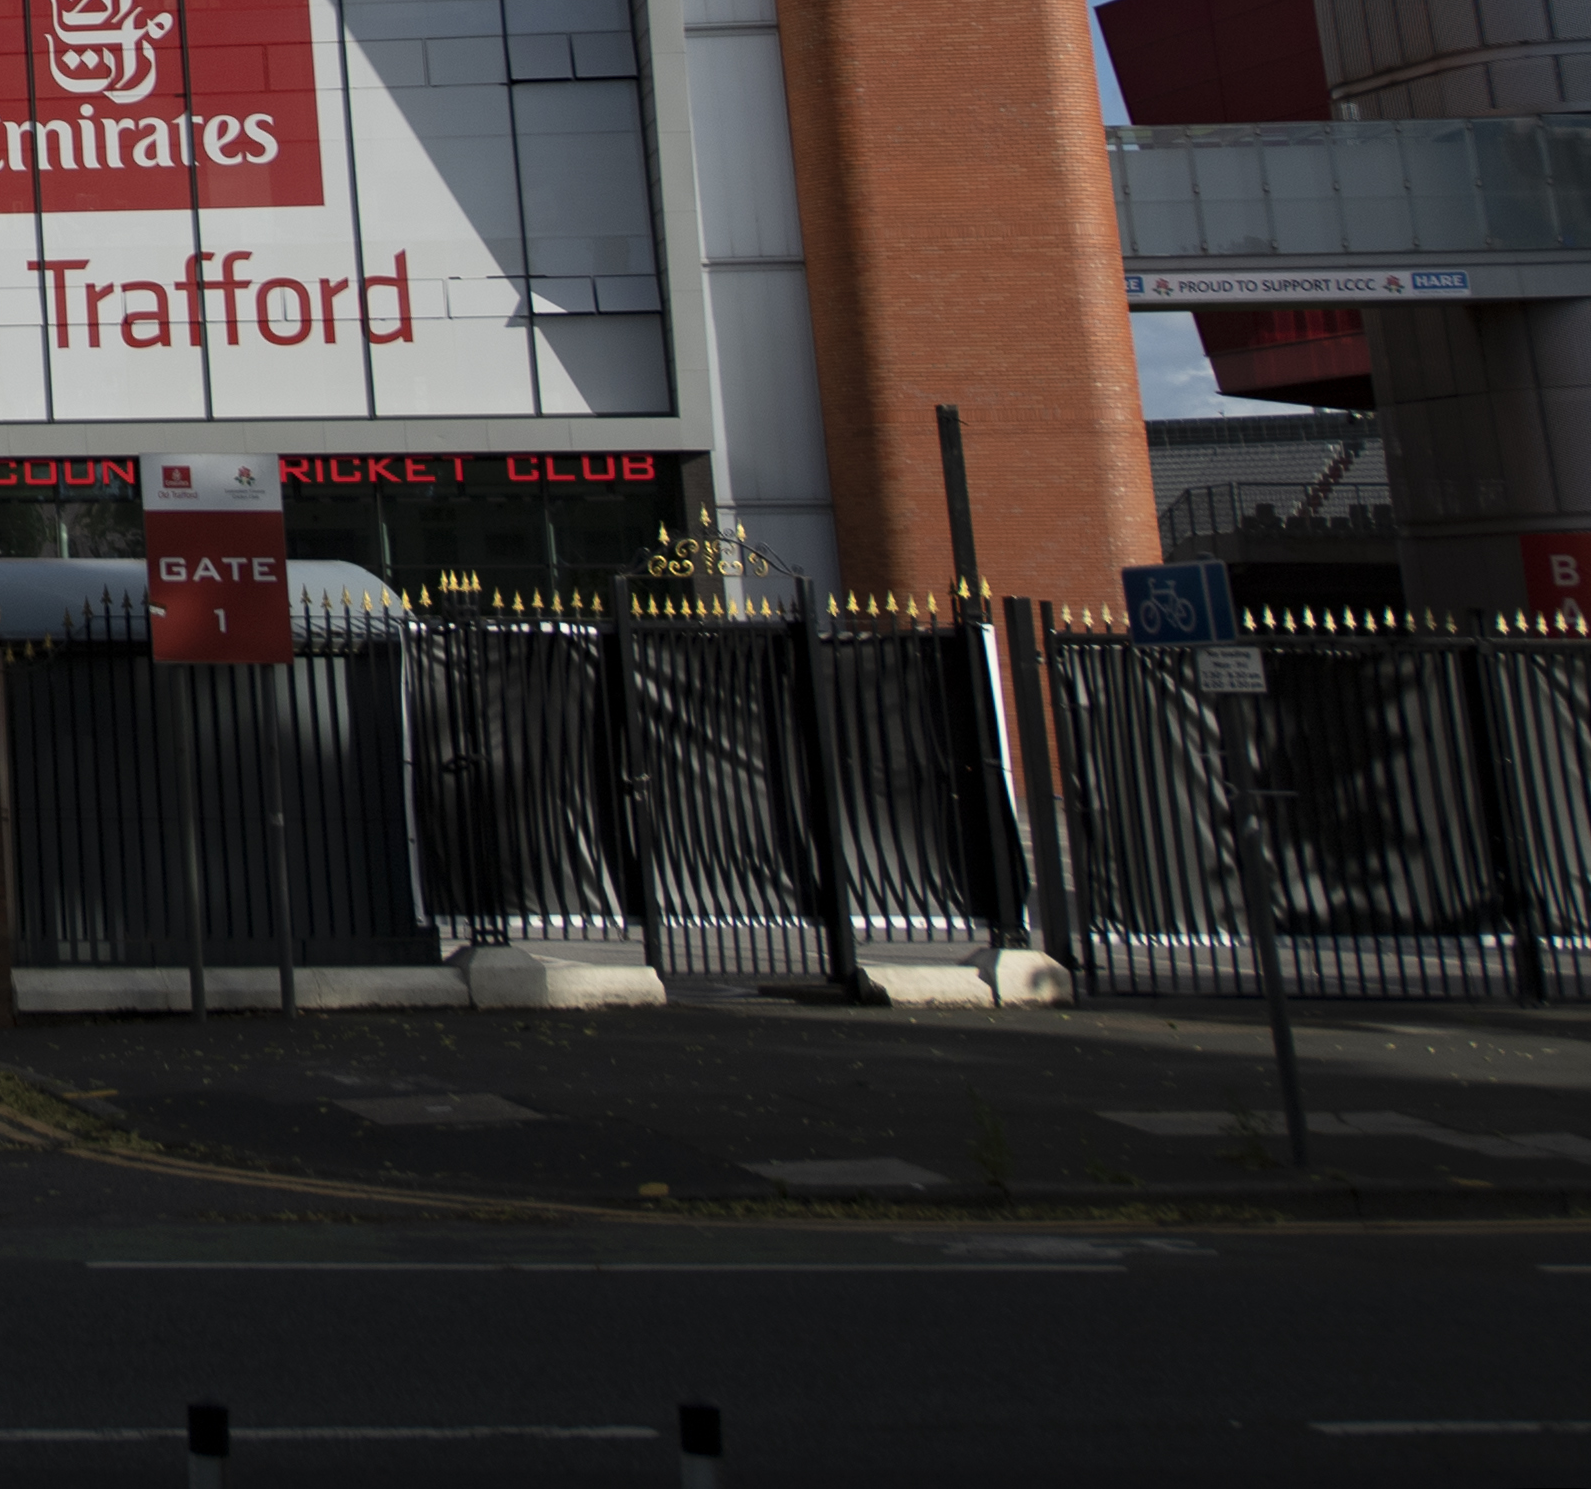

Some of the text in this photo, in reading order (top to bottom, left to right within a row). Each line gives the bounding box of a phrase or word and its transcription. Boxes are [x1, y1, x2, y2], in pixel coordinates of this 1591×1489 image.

[1178, 277, 1378, 294] PROUD TO SUPPORT LCCC
[1415, 274, 1465, 287] HARE
[27, 249, 414, 349] Trafford
[277, 454, 474, 484] RICKET
[506, 454, 656, 482] CLUB
[159, 556, 278, 582] GATE
[214, 608, 227, 634] 1
